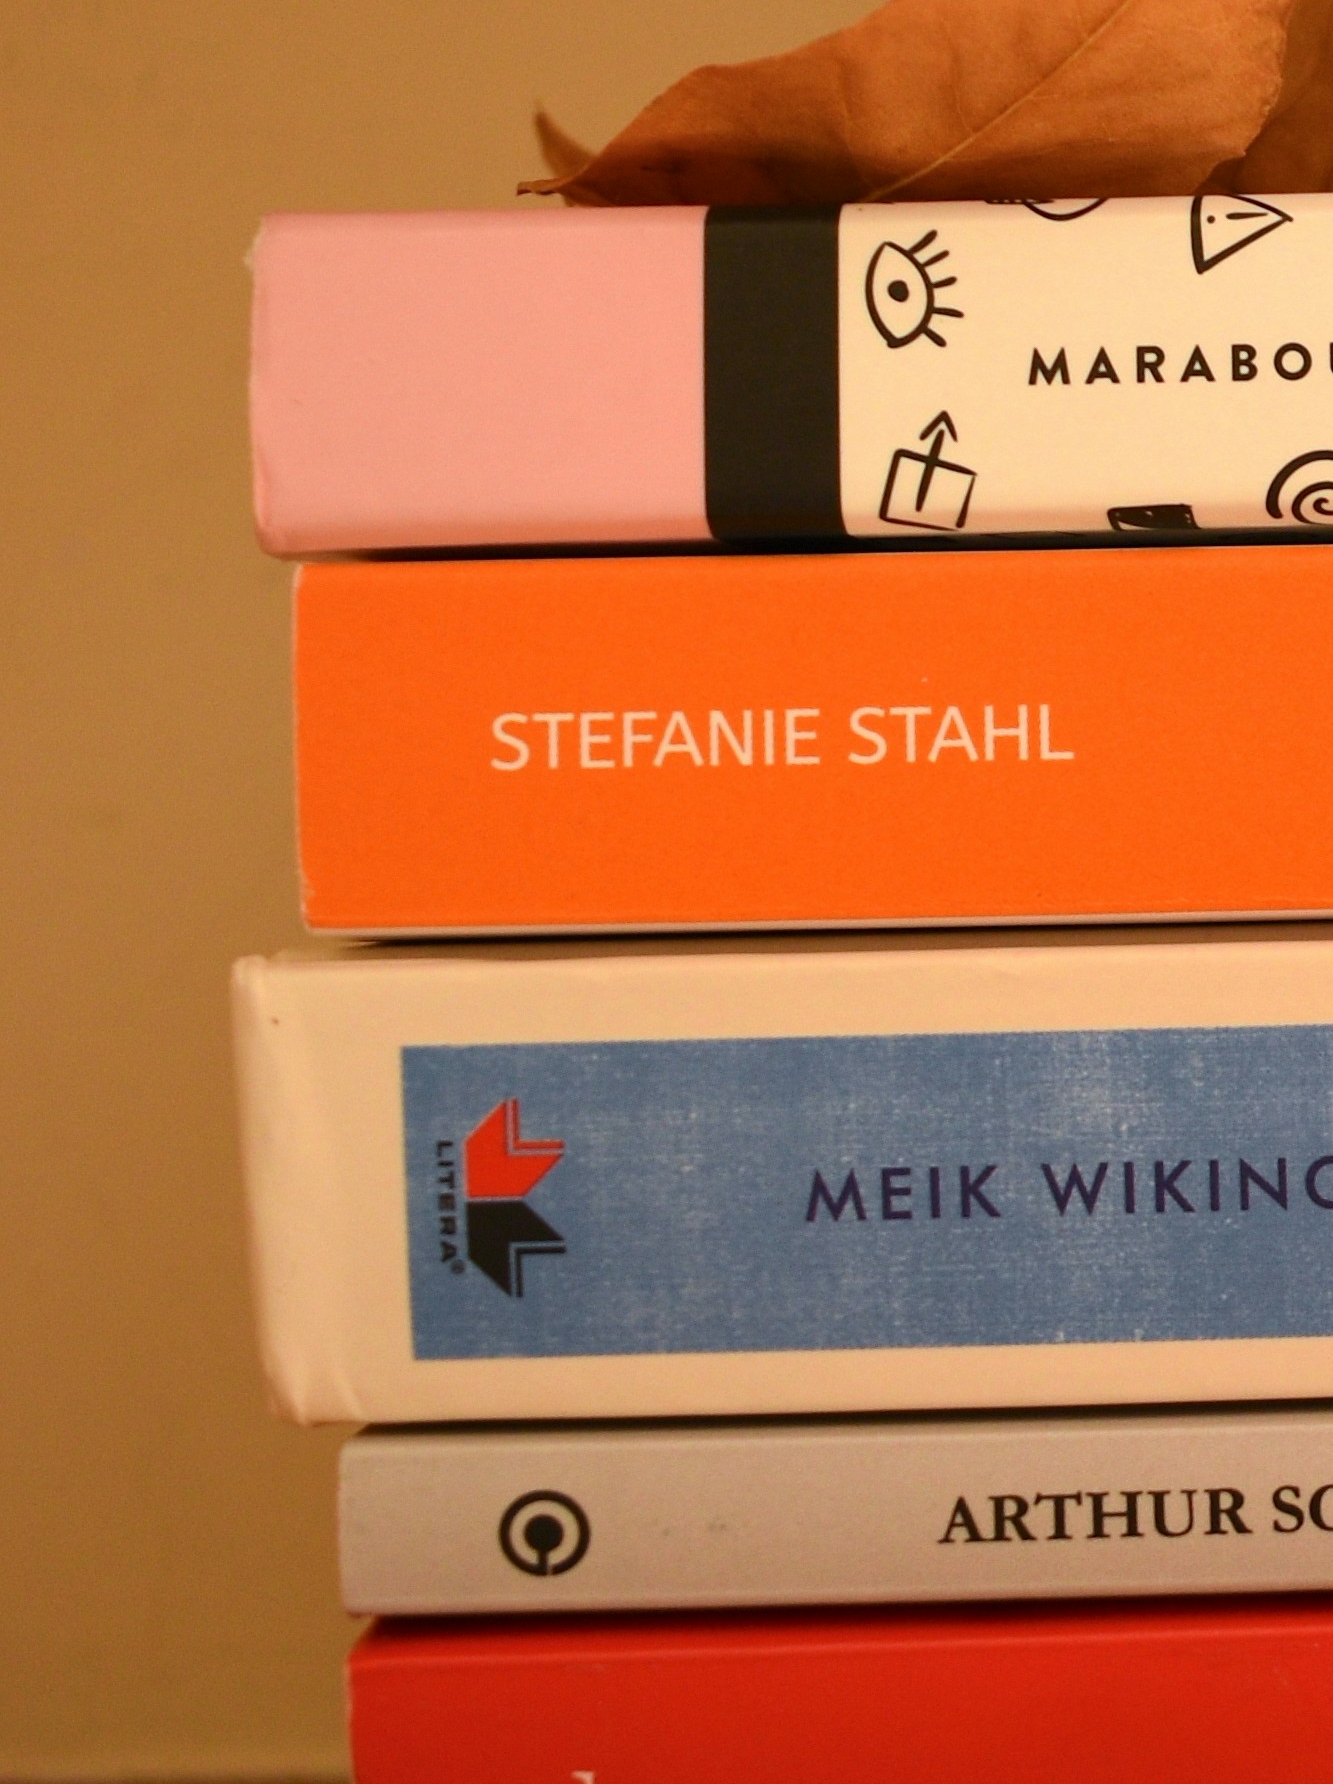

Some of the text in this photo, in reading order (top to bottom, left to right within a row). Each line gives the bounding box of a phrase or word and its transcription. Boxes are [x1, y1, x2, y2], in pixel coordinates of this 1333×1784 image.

[490, 703, 1076, 772] STEFANIE STAHL
[436, 1140, 457, 1263] LITERA
[804, 1155, 1002, 1223] MEIK
[937, 1487, 1252, 1546] ARTHUR
